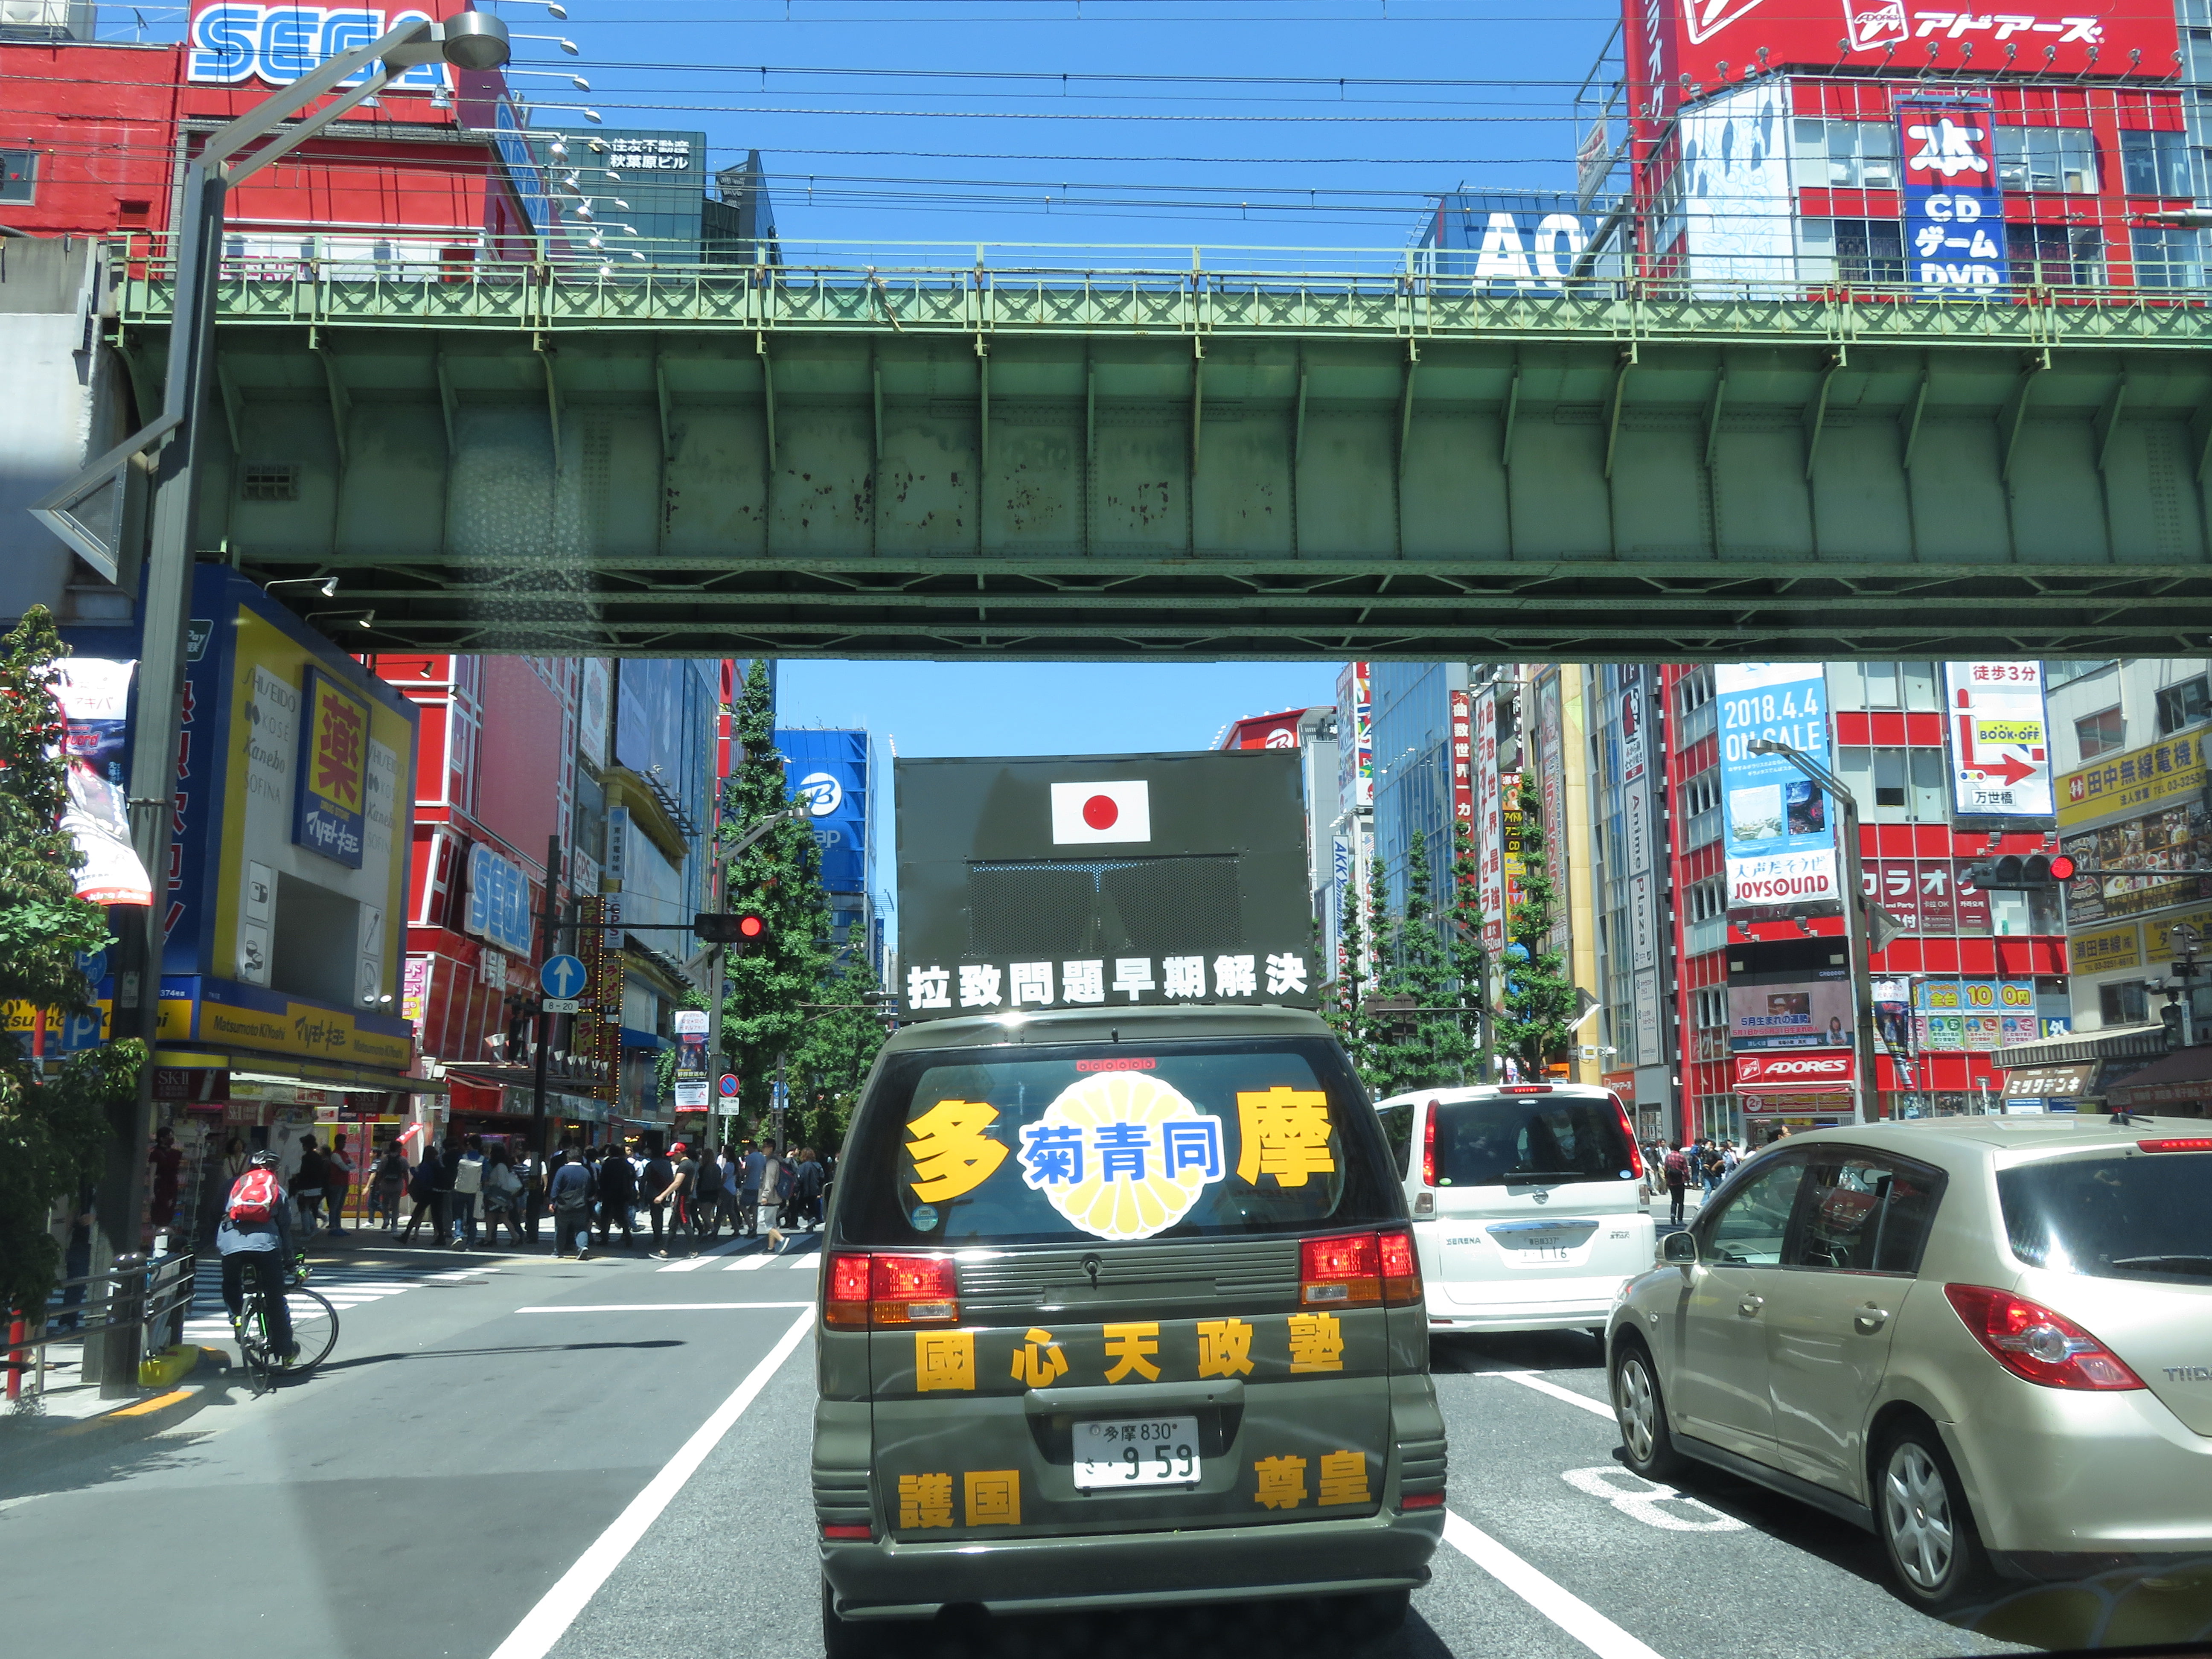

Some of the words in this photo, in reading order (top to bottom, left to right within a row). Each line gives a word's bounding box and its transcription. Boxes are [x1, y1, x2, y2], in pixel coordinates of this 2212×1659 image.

[1914, 12, 2103, 44] アドアーズ
[611, 138, 689, 155] 住友不動産
[1908, 118, 1988, 177] 本
[610, 155, 688, 170] 秋葉原ビル
[1924, 194, 1981, 223] CD
[1472, 213, 1605, 292] AO
[1915, 226, 1998, 259] ゲーム
[1920, 263, 2000, 294] DVD
[1972, 665, 2036, 682] 徒歩3分
[1724, 687, 1819, 729] 2018.4.4
[318, 693, 361, 806] 薬
[1452, 703, 1470, 789] 曲数世界一
[1763, 721, 1822, 757] SALE
[1974, 792, 2014, 804] 万世橋
[1508, 841, 1520, 851] CD
[464, 844, 531, 959] SEGA
[1734, 875, 1829, 900] JOYSOUND
[1636, 877, 1645, 946] Plaza
[907, 952, 1309, 1010] 拉致問題早期解決
[579, 998, 596, 1007] 2F
[1930, 991, 1959, 1007] 全台
[158, 1071, 189, 1085] SK-II
[1764, 1059, 1847, 1074] ADORES
[2008, 1076, 2081, 1095] ミツワデンキ
[1749, 1098, 1761, 1107] 2F
[905, 1099, 1010, 1203] 多
[1235, 1086, 1335, 1187] 摩
[1024, 1121, 1220, 1185] 菊青同
[1447, 1237, 1481, 1246] SERENA
[915, 1312, 1345, 1392] 國心天政塾
[2162, 1365, 2212, 1382] TIID
[1103, 1425, 1137, 1443] 多摩
[1141, 1423, 1171, 1441] 830
[1253, 1449, 1371, 1510] 尊皇
[898, 1469, 1021, 1530] 護国
